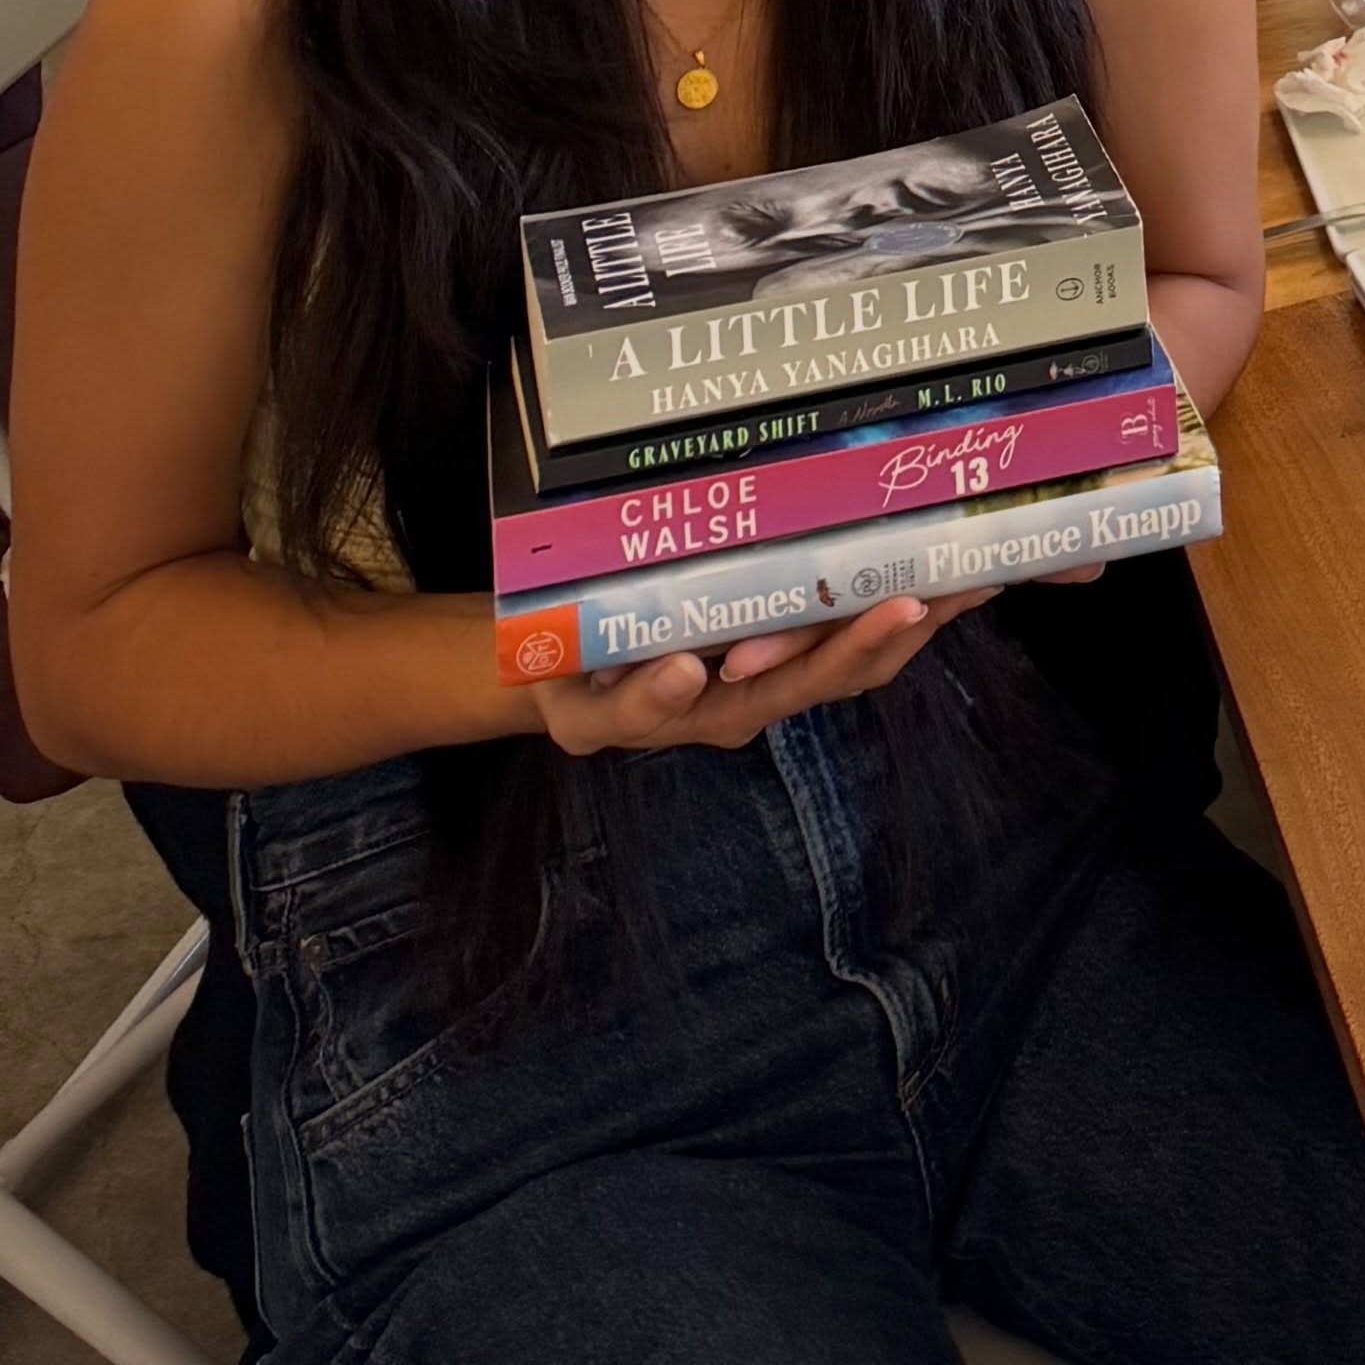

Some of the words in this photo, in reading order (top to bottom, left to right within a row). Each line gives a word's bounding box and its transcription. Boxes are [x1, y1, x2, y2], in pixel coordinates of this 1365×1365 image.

[990, 152, 1045, 212] HANYA
[1026, 112, 1108, 224] YANAGIHARA
[655, 224, 716, 277] LIFE
[608, 335, 647, 381] A
[667, 287, 882, 371] LITTLE
[903, 259, 1031, 324] LIFE
[651, 368, 770, 415] HANYA
[782, 321, 1001, 383] YANAGIHARA
[628, 428, 749, 470] GRAVEYARD
[759, 411, 820, 444] SHIFT
[917, 388, 938, 410] M.
[943, 383, 962, 405] L.
[972, 373, 1006, 398] RIO
[619, 475, 758, 528] CHLOE
[878, 422, 1025, 509] Binding
[951, 457, 990, 495] 13
[598, 615, 672, 656] The
[681, 585, 807, 639] Names
[926, 523, 1082, 584] Florence
[1088, 496, 1202, 549] Knapp
[619, 508, 758, 563] WALSH
